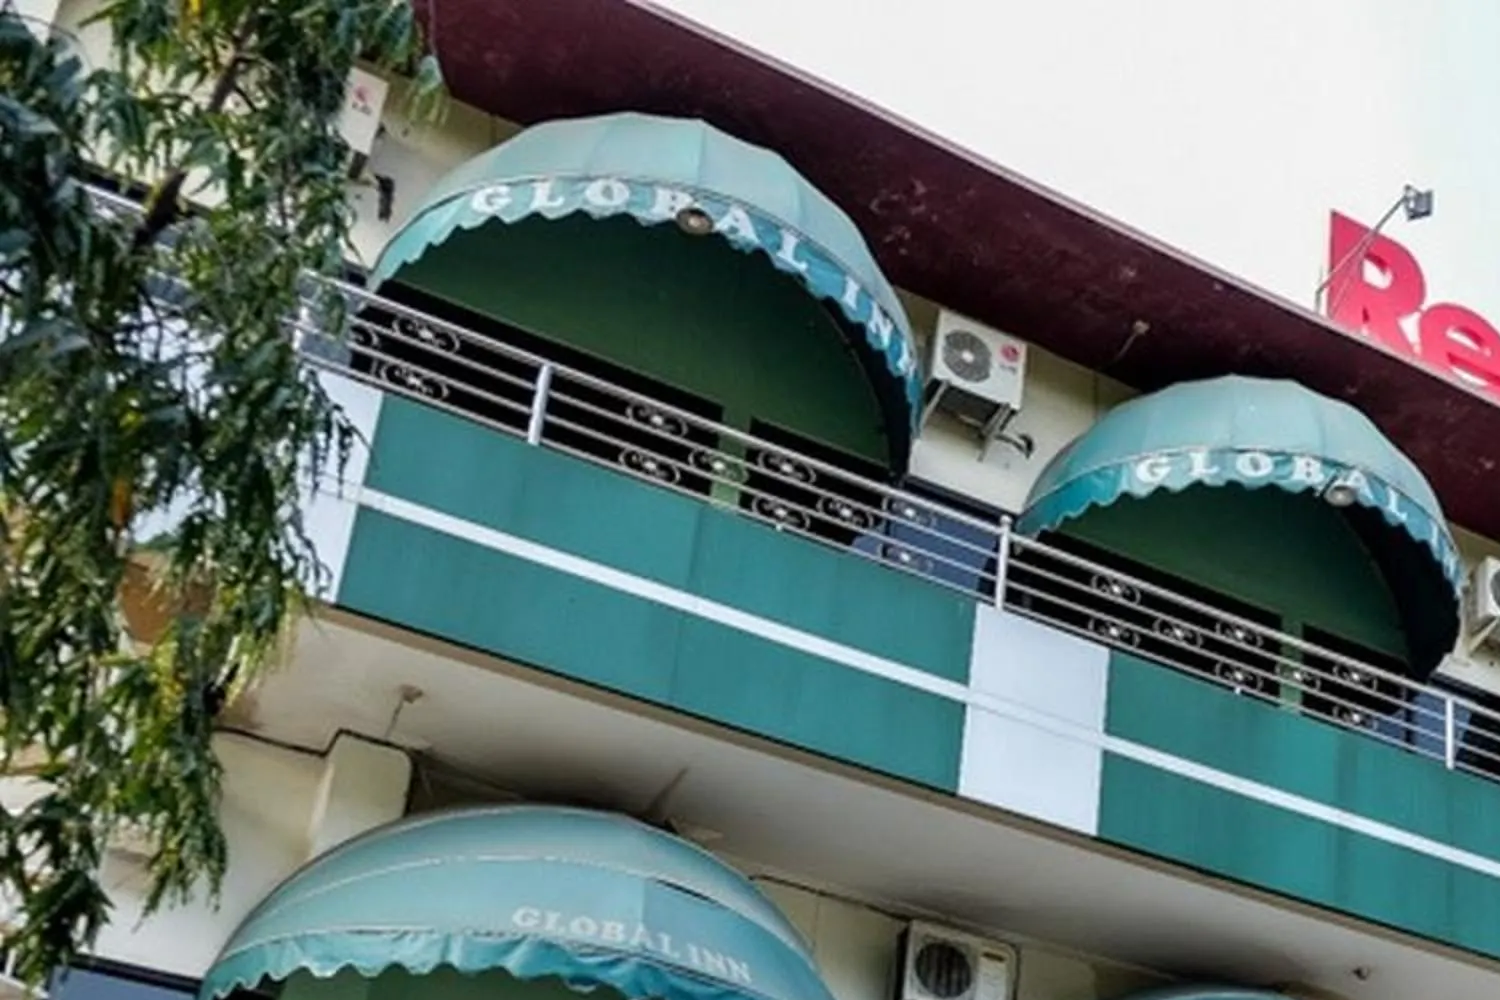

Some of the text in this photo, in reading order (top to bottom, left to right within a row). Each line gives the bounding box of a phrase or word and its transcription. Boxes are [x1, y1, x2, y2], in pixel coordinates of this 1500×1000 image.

[470, 177, 808, 272] GLOBAL
[1135, 448, 1407, 519] GLOBAL
[511, 906, 755, 984] GLOBAL INN
